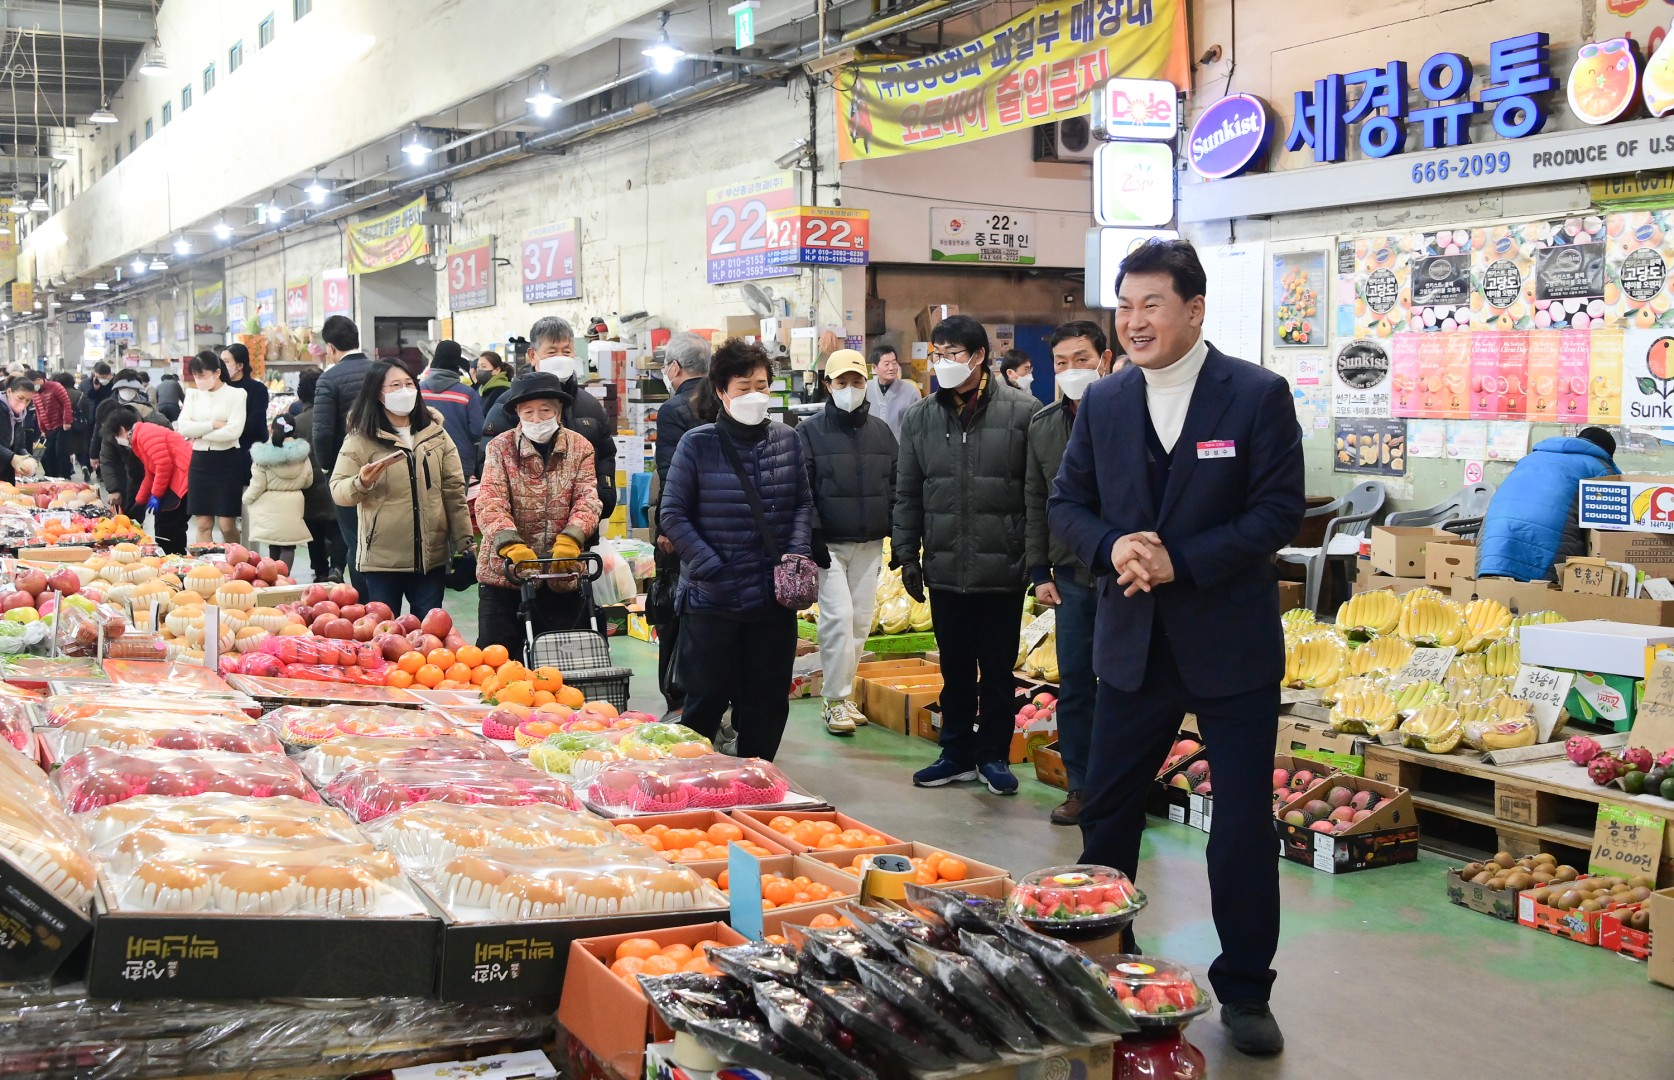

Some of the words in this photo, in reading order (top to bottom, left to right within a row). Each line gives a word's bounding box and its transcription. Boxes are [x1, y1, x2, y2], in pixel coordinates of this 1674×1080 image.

[1070, 0, 1153, 43] 매장내
[901, 84, 988, 145] 오토바이
[995, 47, 1110, 126] 출입금지
[1285, 32, 1562, 163] 세경유통
[1112, 91, 1172, 122] Dole
[1192, 111, 1260, 163] Sunkist
[1532, 144, 1608, 169] PRODUCE
[1616, 139, 1639, 158] OF
[1411, 150, 1511, 184] 666-2099
[710, 199, 767, 255] 22
[991, 214, 1011, 231] 22
[805, 219, 851, 248] 22
[853, 236, 864, 249] 번
[523, 239, 559, 281] 37
[564, 255, 573, 275] 번
[712, 260, 726, 271] H.P
[451, 253, 477, 291] 31
[712, 270, 726, 281] H.P
[1624, 265, 1662, 282] 고당도
[1369, 283, 1396, 297] 고당도
[1486, 275, 1519, 291] 고당도
[288, 289, 303, 314] 36
[327, 280, 339, 308] 9
[110, 322, 129, 332] 28
[1338, 352, 1388, 370] Sunkist
[1630, 401, 1673, 419] Sunk
[1585, 486, 1627, 496] Bananas
[1585, 503, 1627, 513] Bananas
[1585, 512, 1627, 522] Bananas
[1413, 648, 1454, 666] 한송이
[1528, 671, 1560, 691] 한송이
